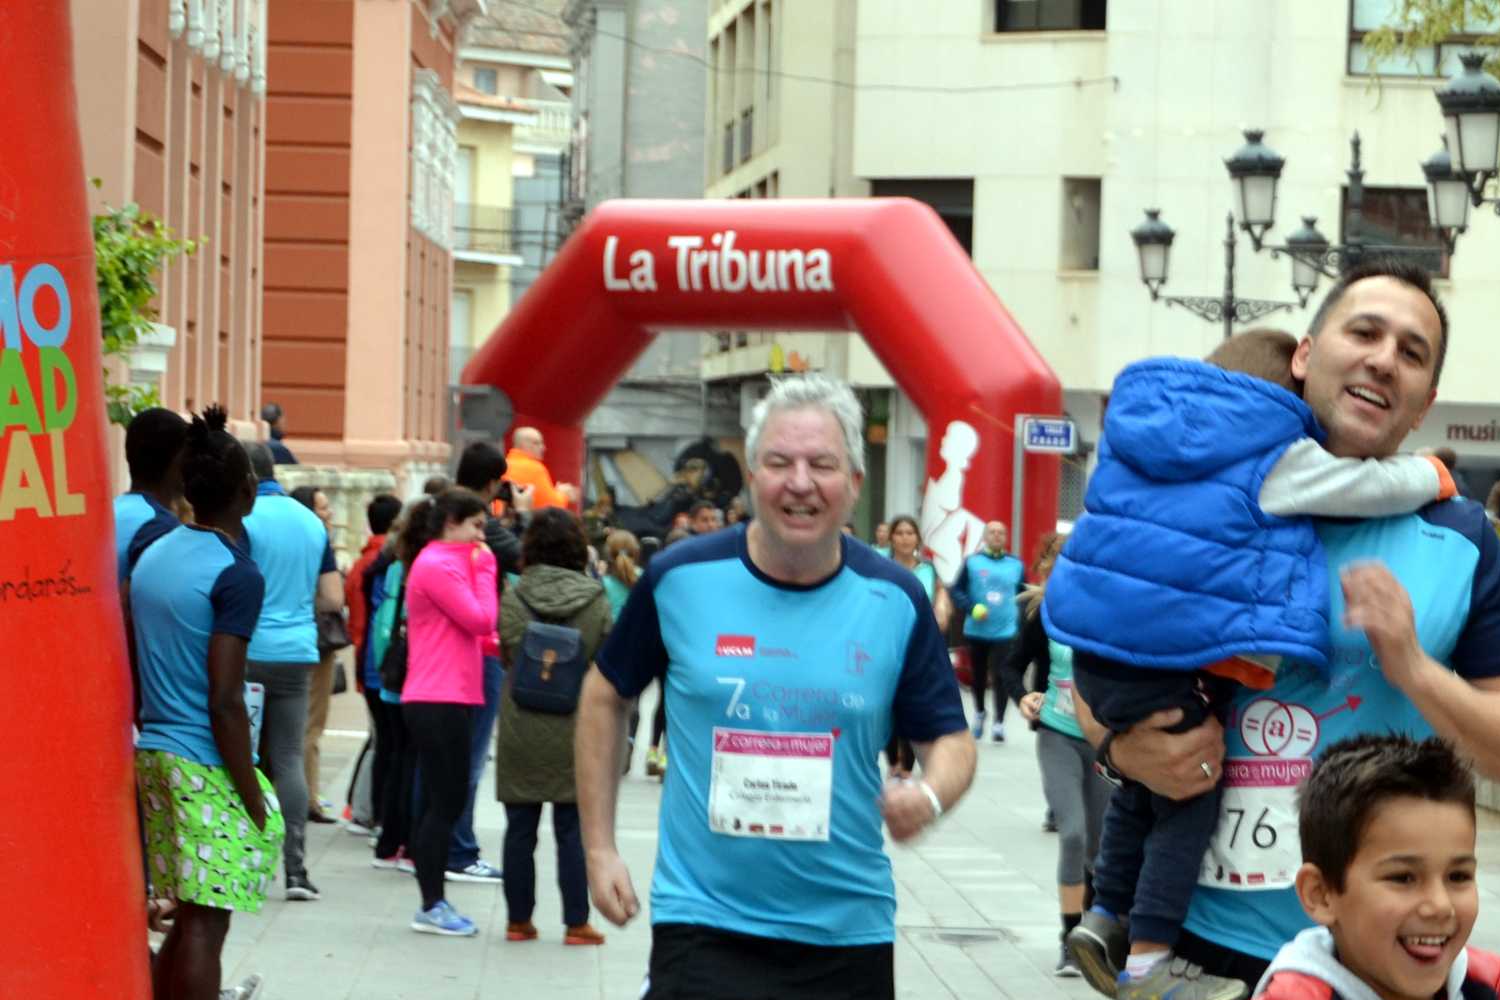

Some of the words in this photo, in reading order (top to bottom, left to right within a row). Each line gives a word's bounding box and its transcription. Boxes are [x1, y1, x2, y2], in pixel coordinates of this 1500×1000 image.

[603, 235, 656, 291] La
[668, 230, 833, 292] Tribuna
[1261, 761, 1308, 784] mujer
